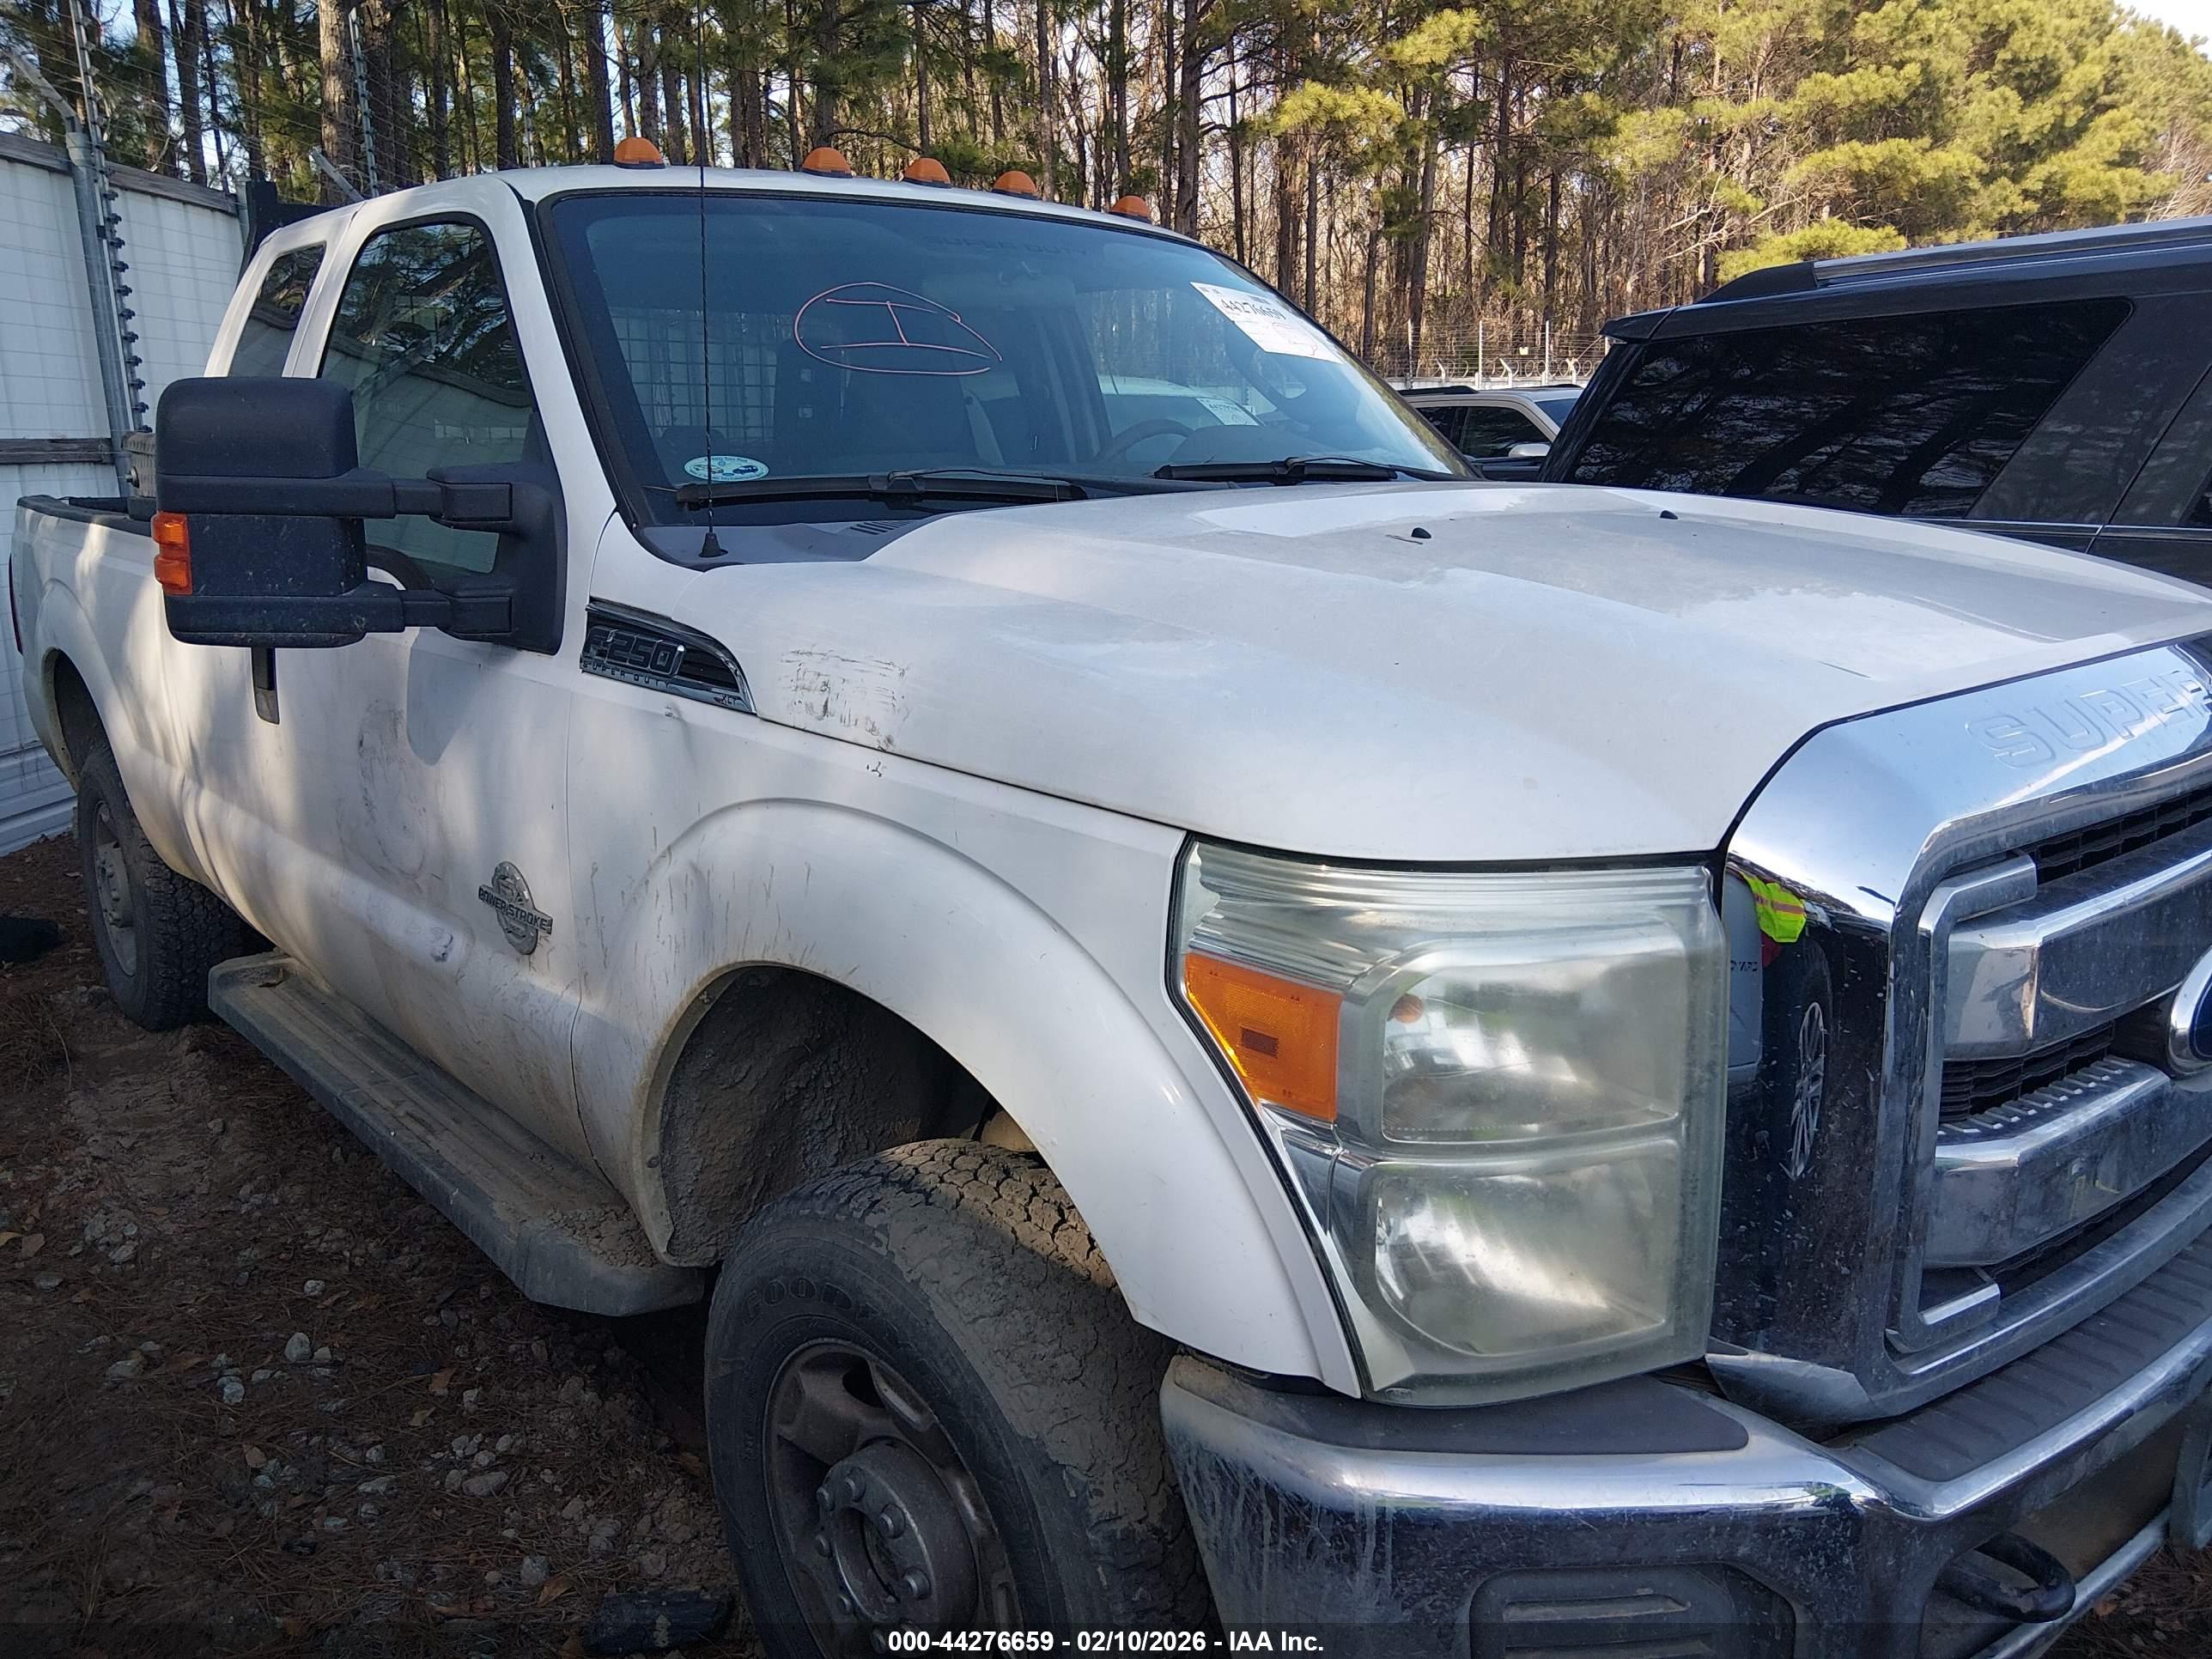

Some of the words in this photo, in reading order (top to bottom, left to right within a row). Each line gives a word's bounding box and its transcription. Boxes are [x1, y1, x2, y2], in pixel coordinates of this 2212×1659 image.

[583, 661, 626, 677] SUPER
[634, 676, 671, 690] DUTY
[478, 885, 507, 912] POWER
[507, 903, 548, 930] STROKE
